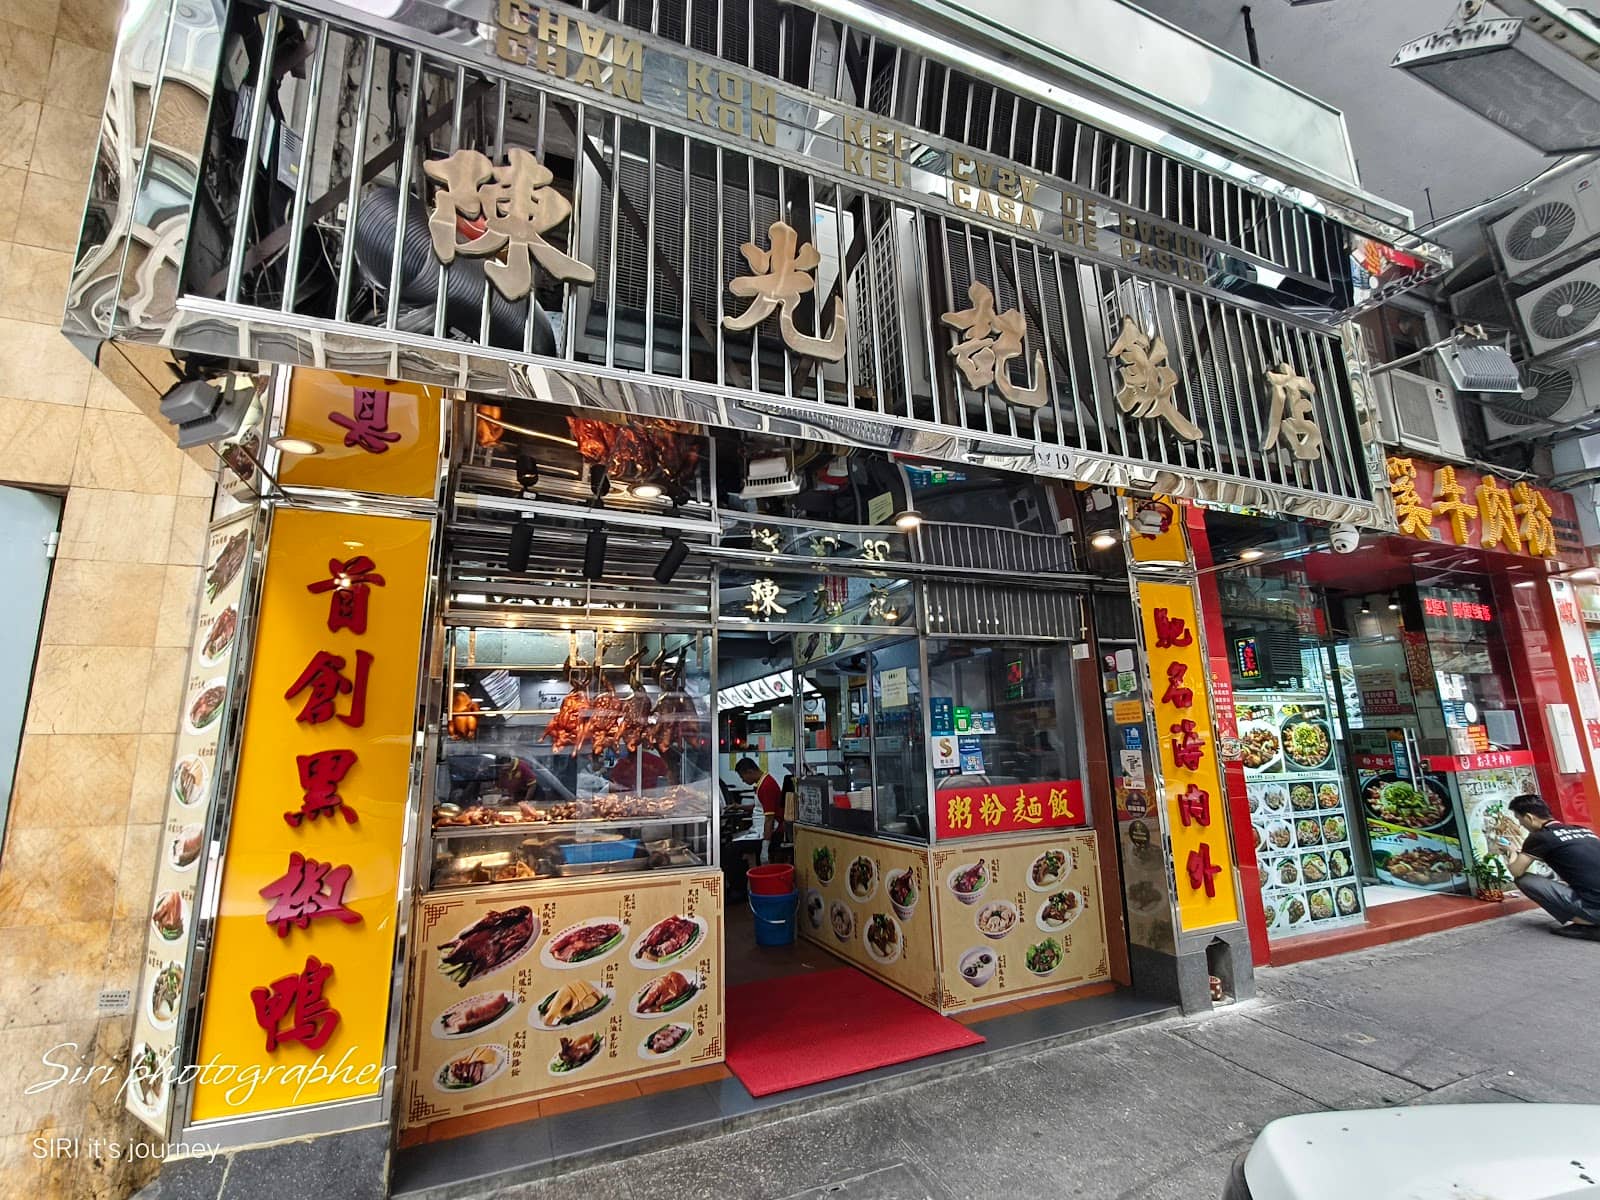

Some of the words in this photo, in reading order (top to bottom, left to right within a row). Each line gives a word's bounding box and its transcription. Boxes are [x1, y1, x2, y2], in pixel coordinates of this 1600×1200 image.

[496, 30, 643, 103] CHAN
[687, 91, 776, 146] KON
[844, 149, 901, 188] KEI
[952, 182, 1038, 232] CASA
[1062, 219, 1099, 251] DE
[1120, 238, 1208, 284] PASTO
[1055, 452, 1070, 470] 19
[946, 788, 1075, 830] 粥粉麵飯
